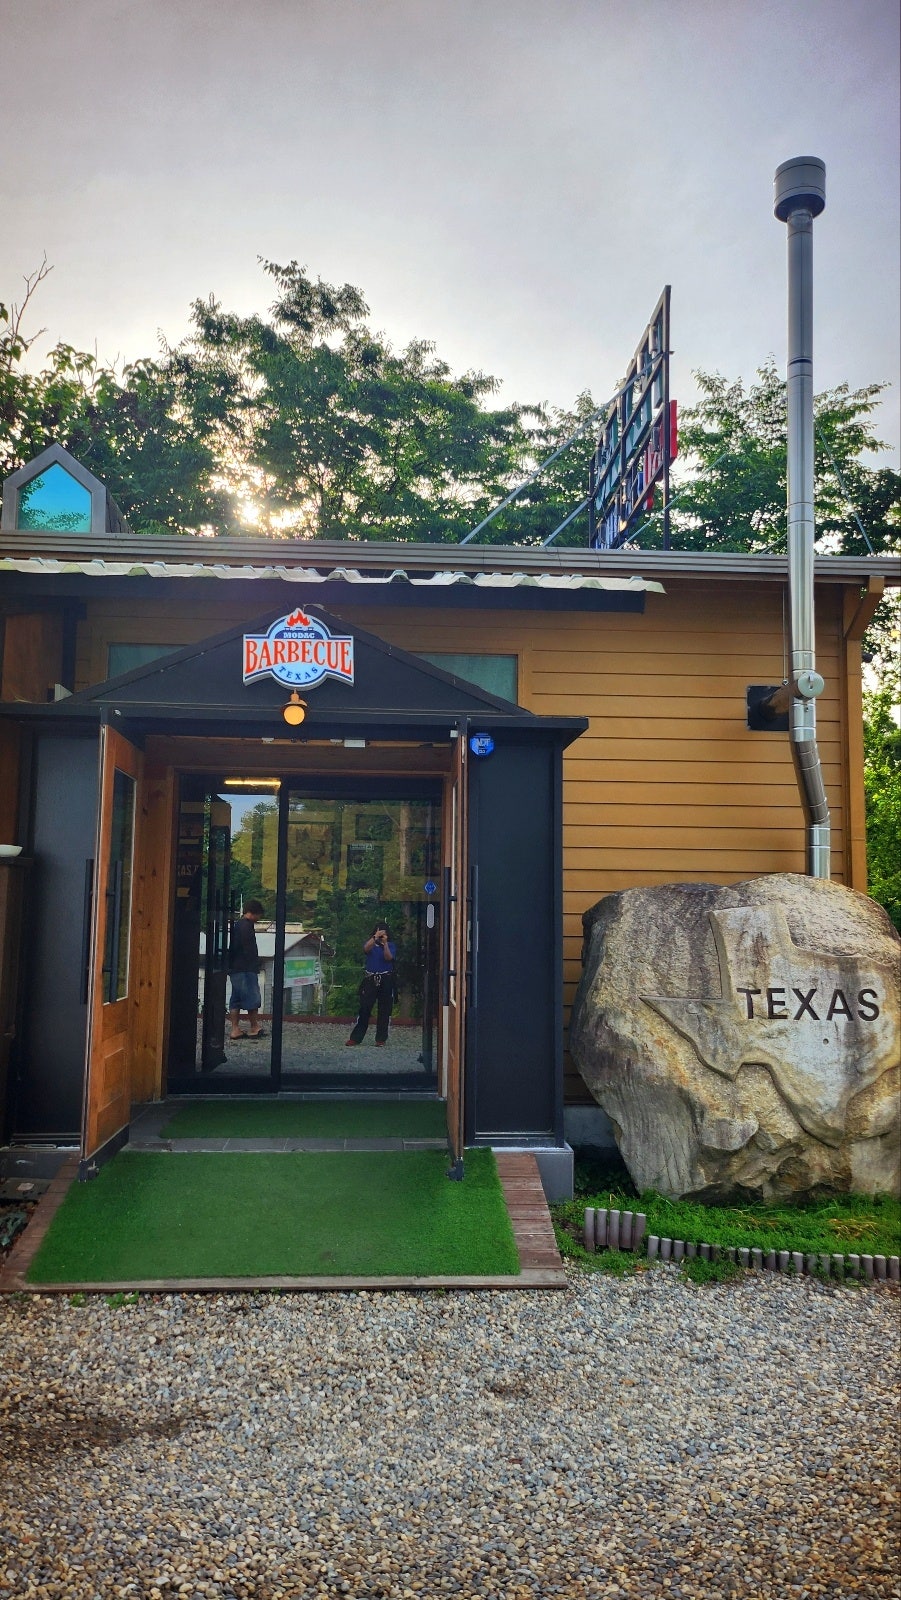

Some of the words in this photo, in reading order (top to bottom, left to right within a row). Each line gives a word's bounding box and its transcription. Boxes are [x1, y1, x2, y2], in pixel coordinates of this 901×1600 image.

[245, 640, 352, 675] BARBECUE
[278, 666, 318, 681] TEXAS
[736, 987, 880, 1022] TEXAS
